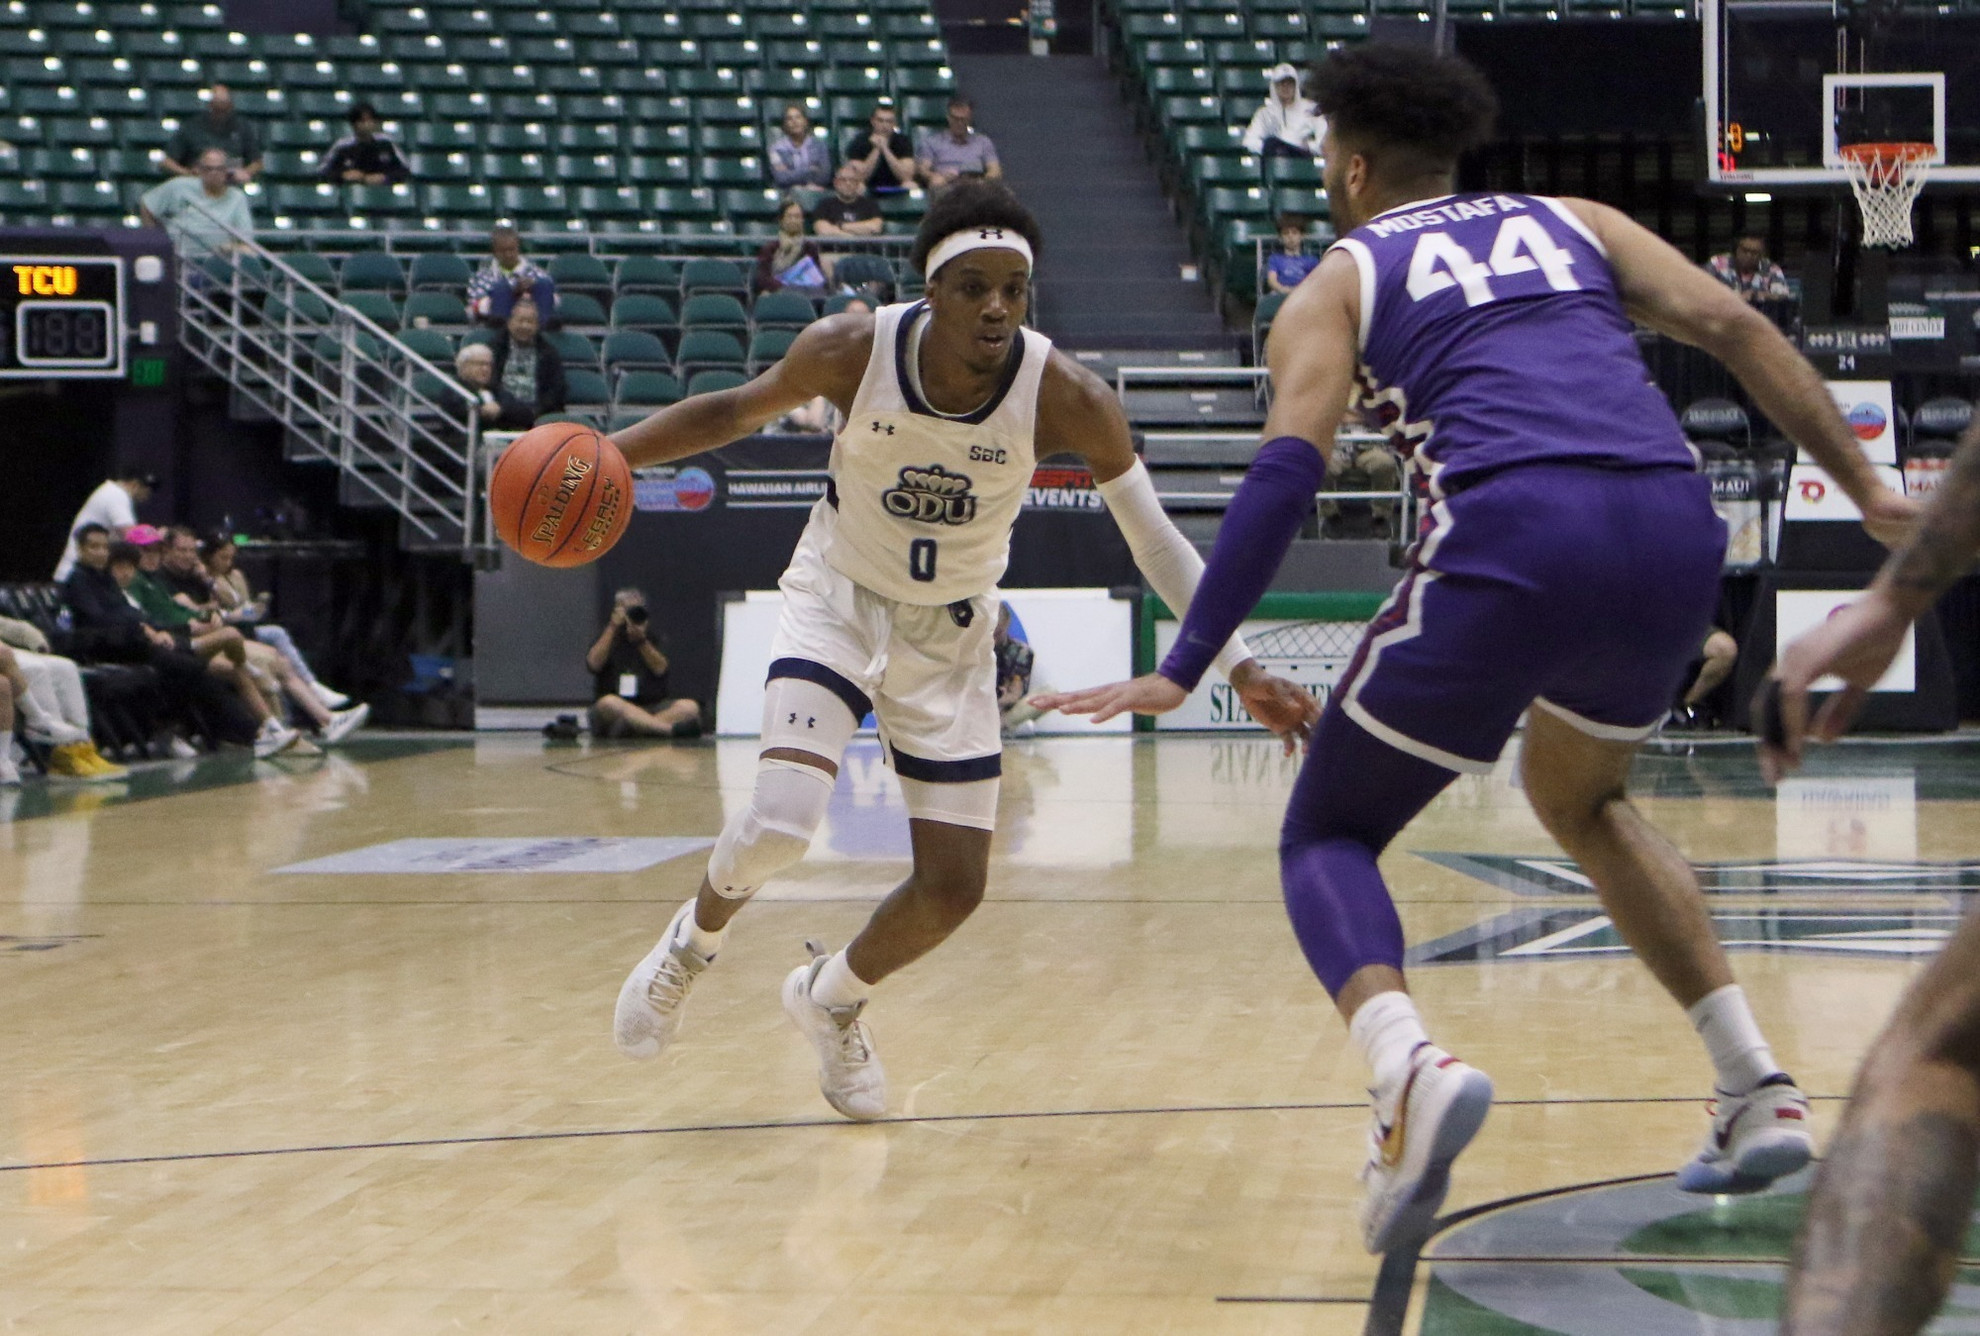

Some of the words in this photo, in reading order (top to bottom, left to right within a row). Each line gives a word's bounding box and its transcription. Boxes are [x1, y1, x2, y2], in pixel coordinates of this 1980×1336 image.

[1366, 195, 1528, 238] MOSTAFA
[1405, 214, 1583, 308] 44
[13, 265, 77, 295] TCU
[969, 445, 1006, 464] SBC
[530, 454, 592, 547] SPALDING
[728, 482, 793, 495] HAWAIIAN
[1022, 488, 1102, 507] EVENTS
[1712, 480, 1750, 493] MAUI
[882, 489, 978, 525] ODU
[910, 538, 937, 582] 0
